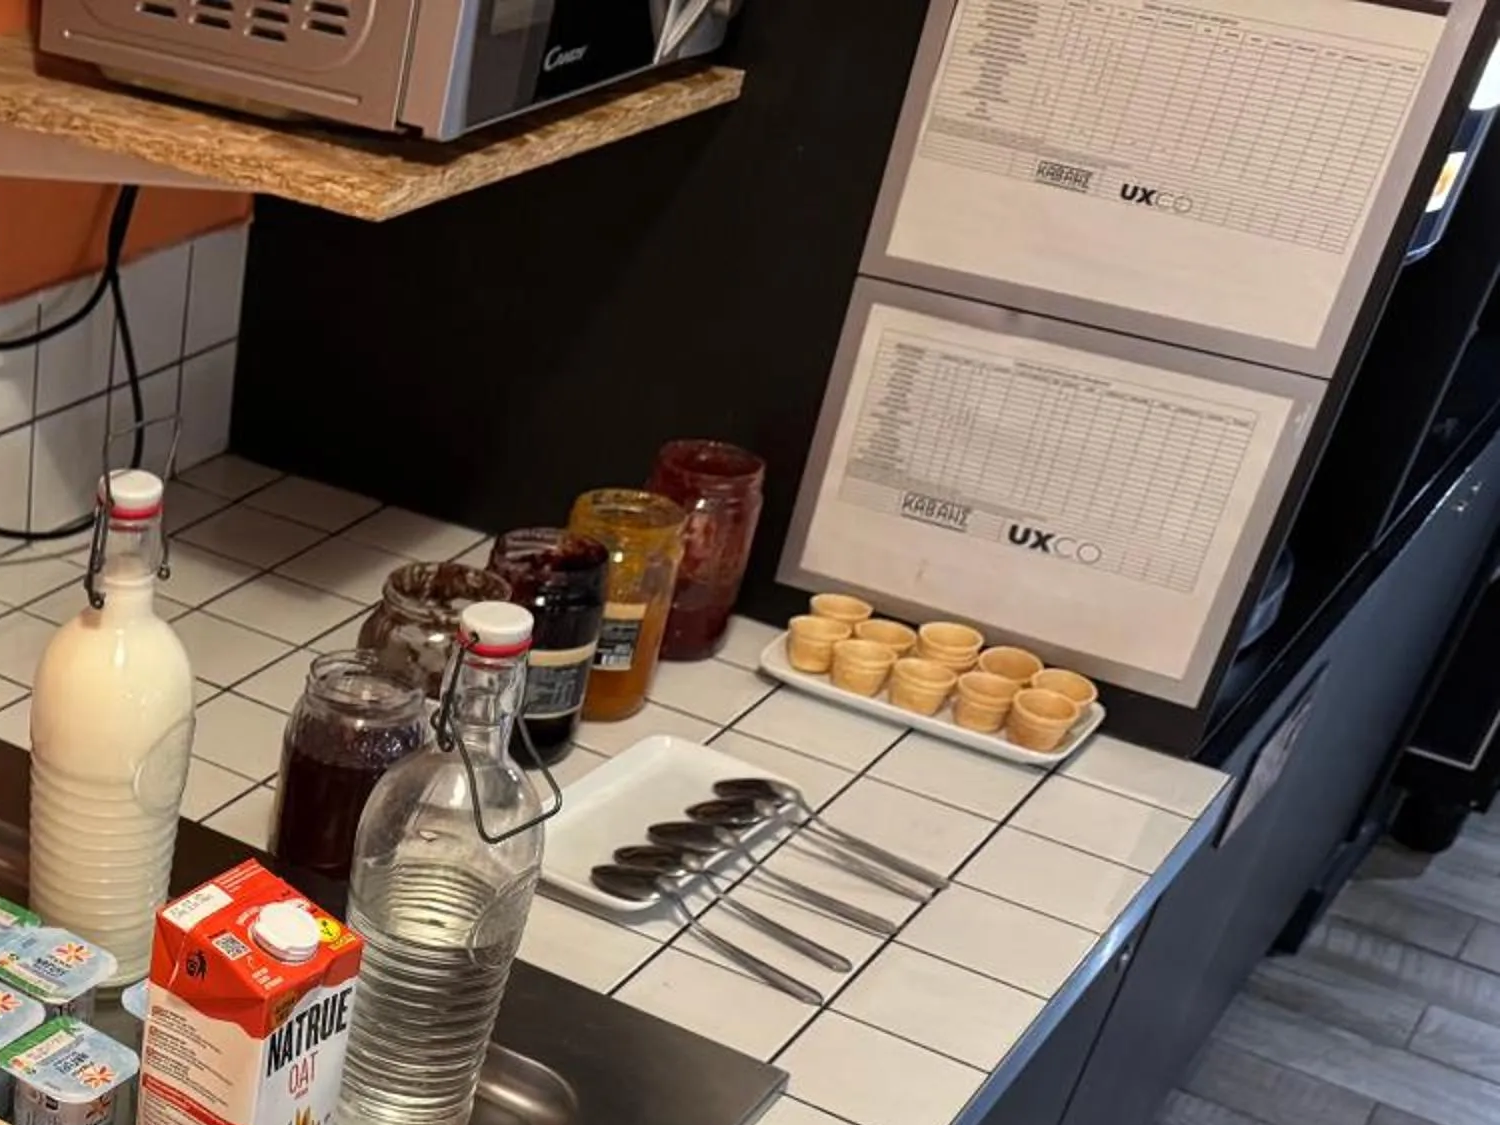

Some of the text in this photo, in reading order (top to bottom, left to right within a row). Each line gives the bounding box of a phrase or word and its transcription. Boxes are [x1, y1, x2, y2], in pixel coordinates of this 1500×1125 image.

[1120, 183, 1192, 213] UXCO
[1007, 524, 1102, 565] UXCO
[266, 987, 353, 1078] NATRUE
[288, 1050, 319, 1095] OAT
